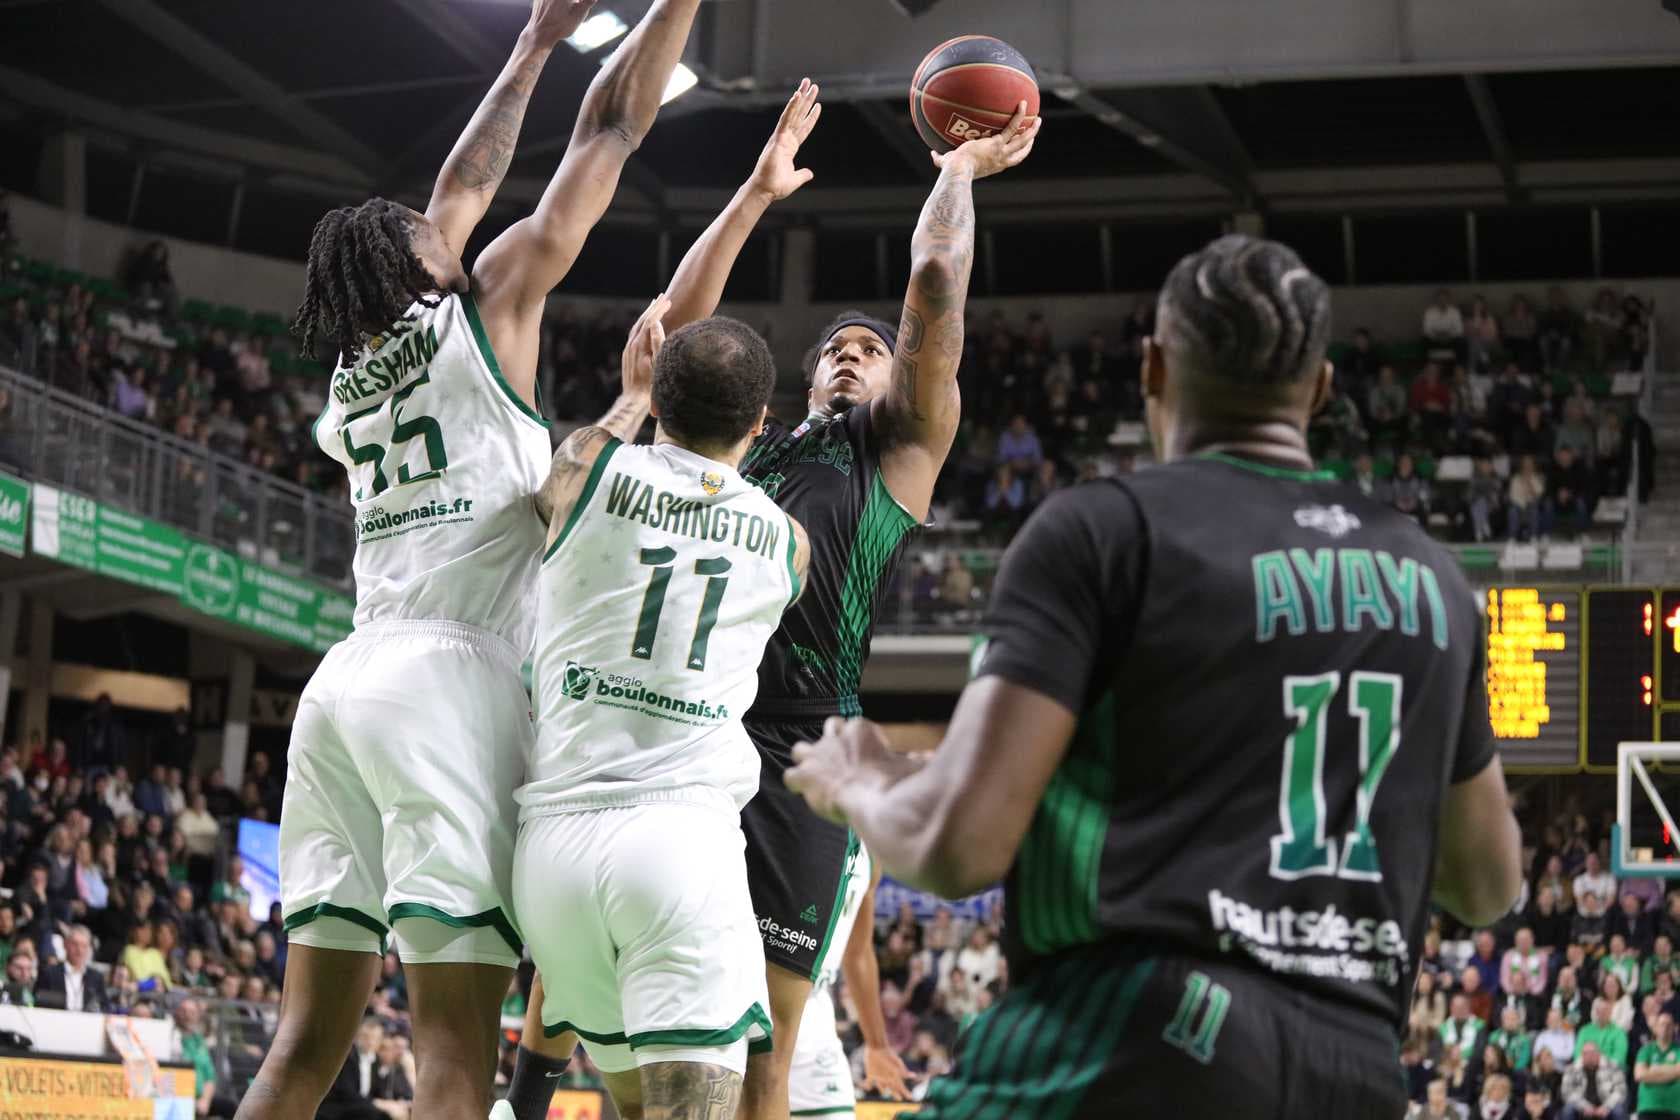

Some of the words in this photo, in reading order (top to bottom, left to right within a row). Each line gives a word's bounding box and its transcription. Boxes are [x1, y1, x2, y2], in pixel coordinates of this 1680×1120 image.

[606, 472, 780, 560] WASHINGTON
[631, 546, 733, 671] 11
[1252, 548, 1448, 650] AYAYI
[608, 674, 642, 687] agglo
[1269, 671, 1403, 882] 11
[768, 935, 798, 954] Sportif
[1162, 969, 1232, 1065] 11
[5, 1066, 66, 1096] VOLETS
